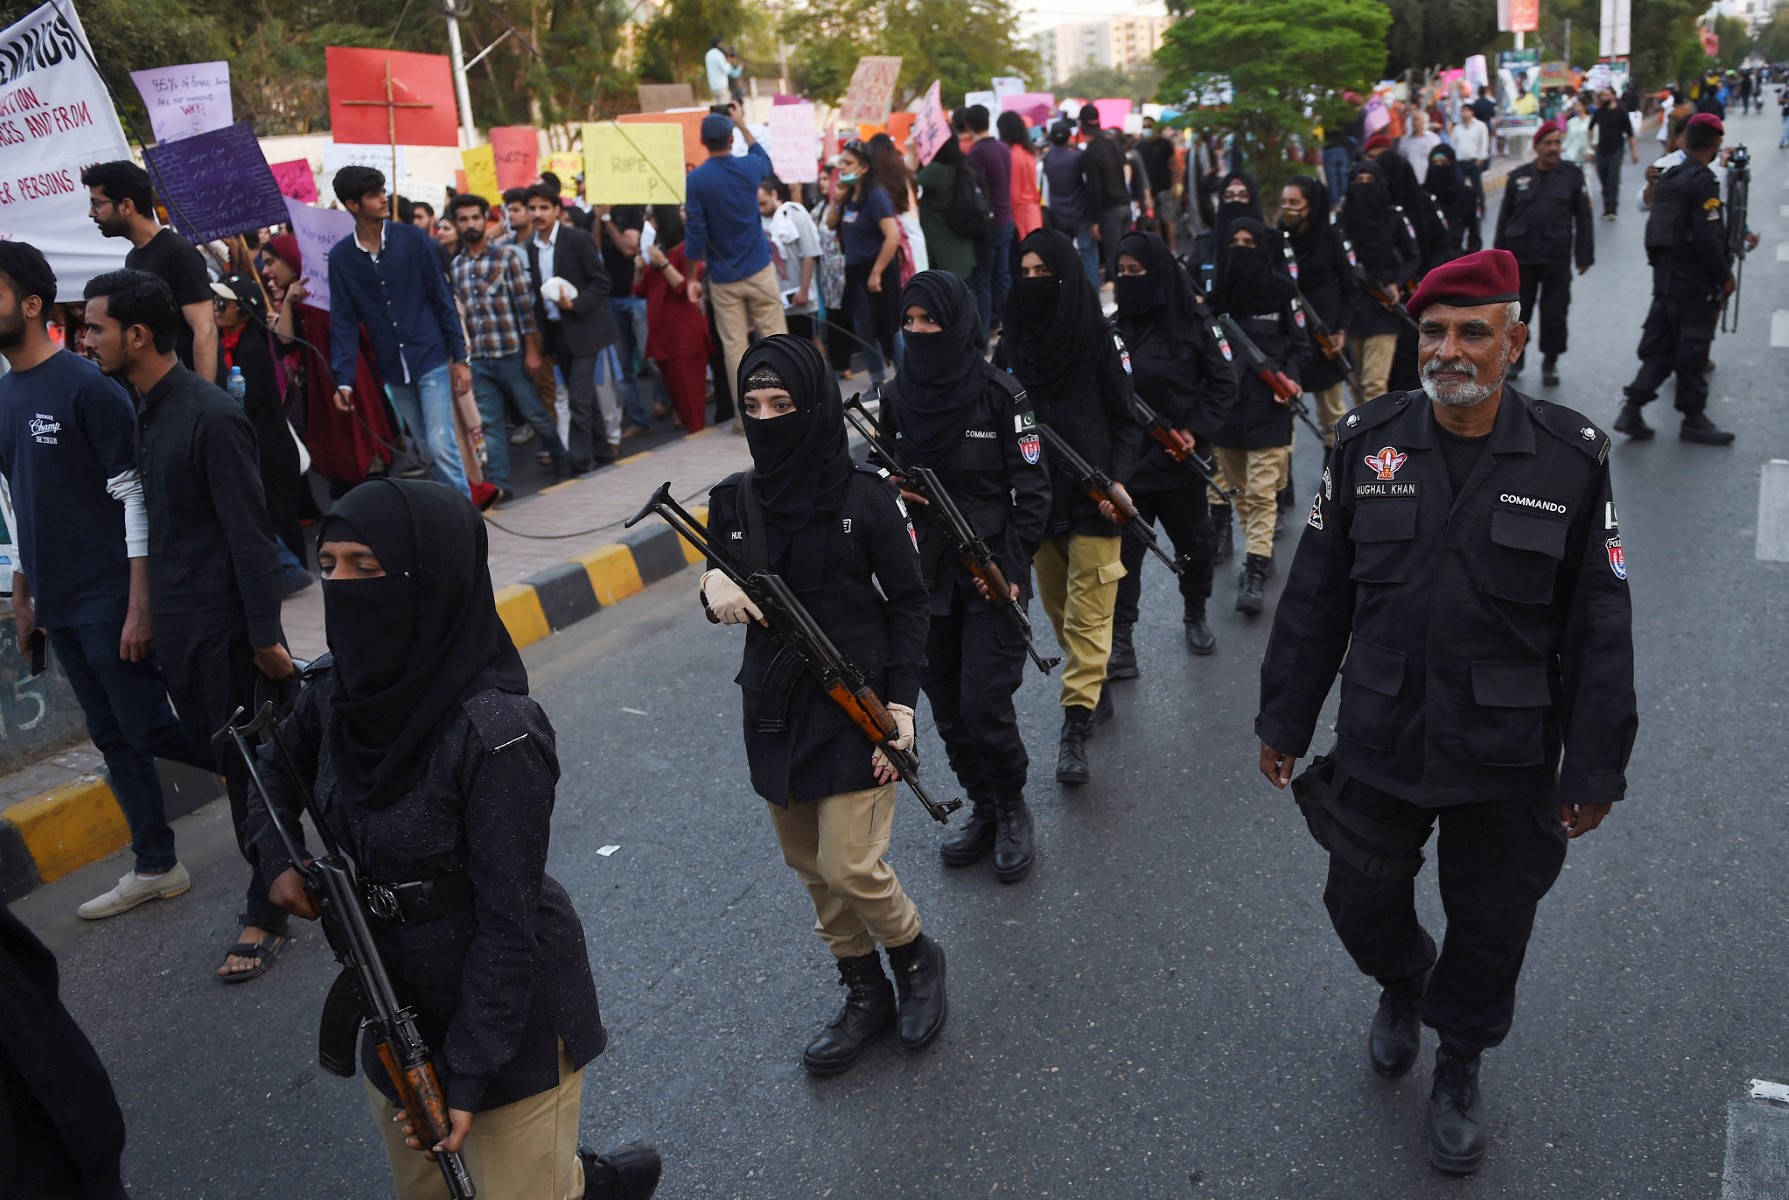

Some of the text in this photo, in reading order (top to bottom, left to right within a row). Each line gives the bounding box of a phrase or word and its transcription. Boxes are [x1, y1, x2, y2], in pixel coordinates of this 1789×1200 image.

[25, 111, 52, 139] AND
[52, 100, 93, 132] FROM
[18, 169, 74, 200] PERSONS
[29, 419, 62, 434] Champ
[1356, 484, 1416, 495] MUGHAL KHAN
[1500, 493, 1567, 514] COMMANDO
